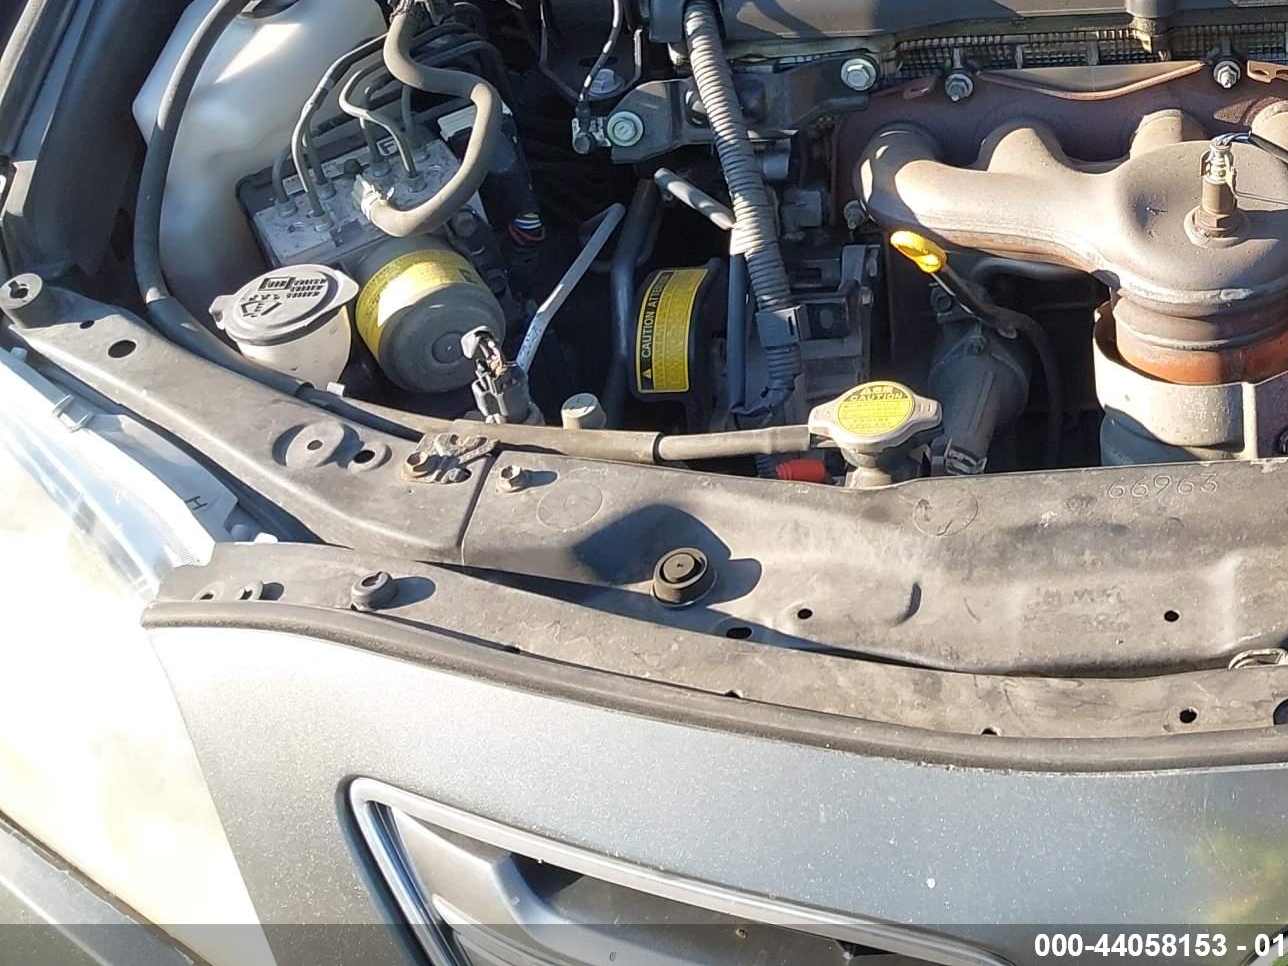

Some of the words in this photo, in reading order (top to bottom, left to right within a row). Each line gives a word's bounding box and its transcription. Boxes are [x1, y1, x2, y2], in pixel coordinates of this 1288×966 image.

[641, 310, 656, 359] CAUTION
[850, 392, 903, 402] CAUTION
[1107, 472, 1218, 499] 66963
